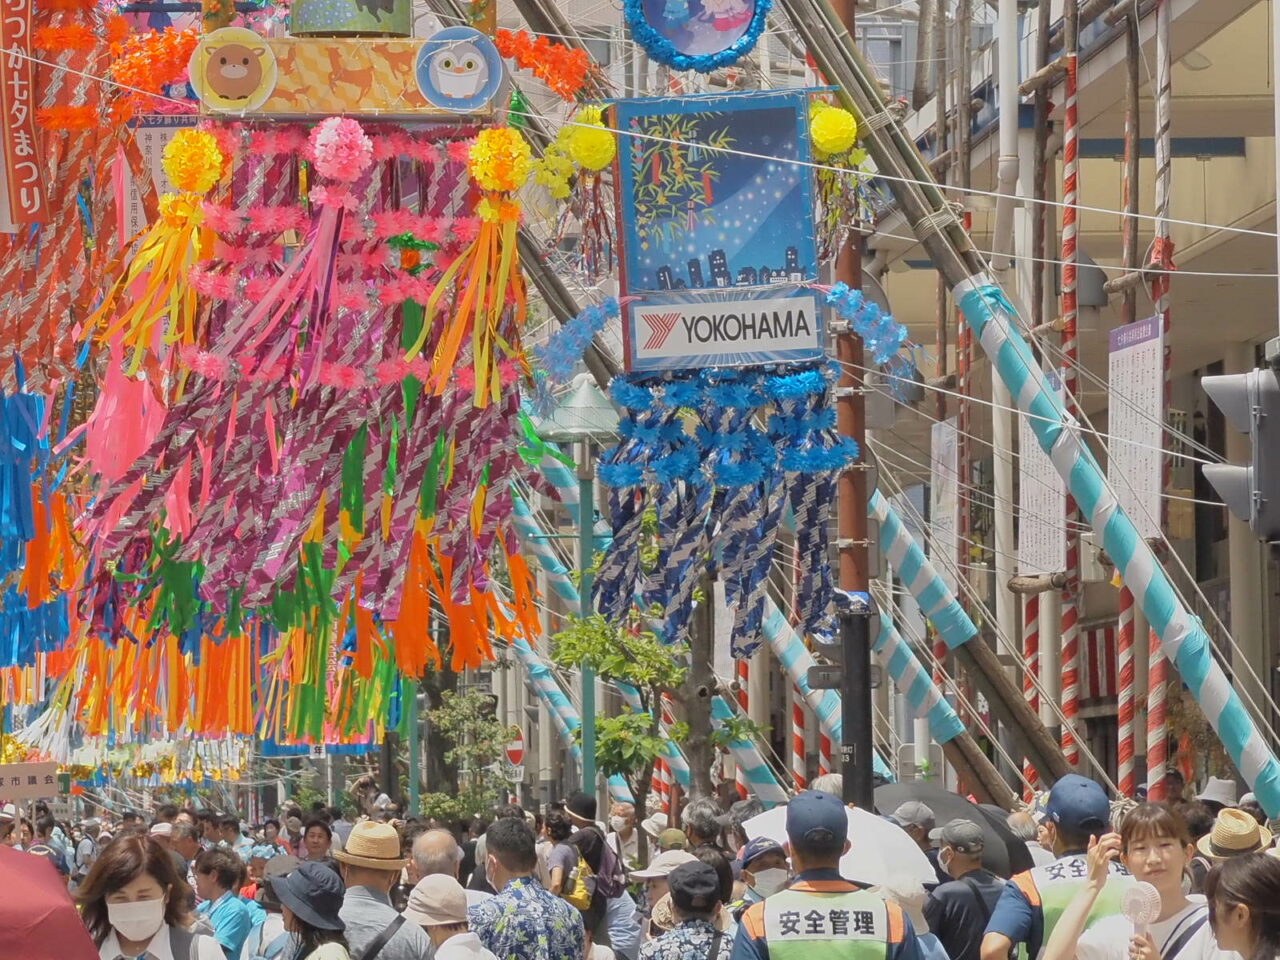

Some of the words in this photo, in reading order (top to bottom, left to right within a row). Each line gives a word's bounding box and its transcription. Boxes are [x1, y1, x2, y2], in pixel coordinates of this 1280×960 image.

[682, 310, 810, 343] YOKOHAMA
[779, 909, 876, 935] 安全管理
